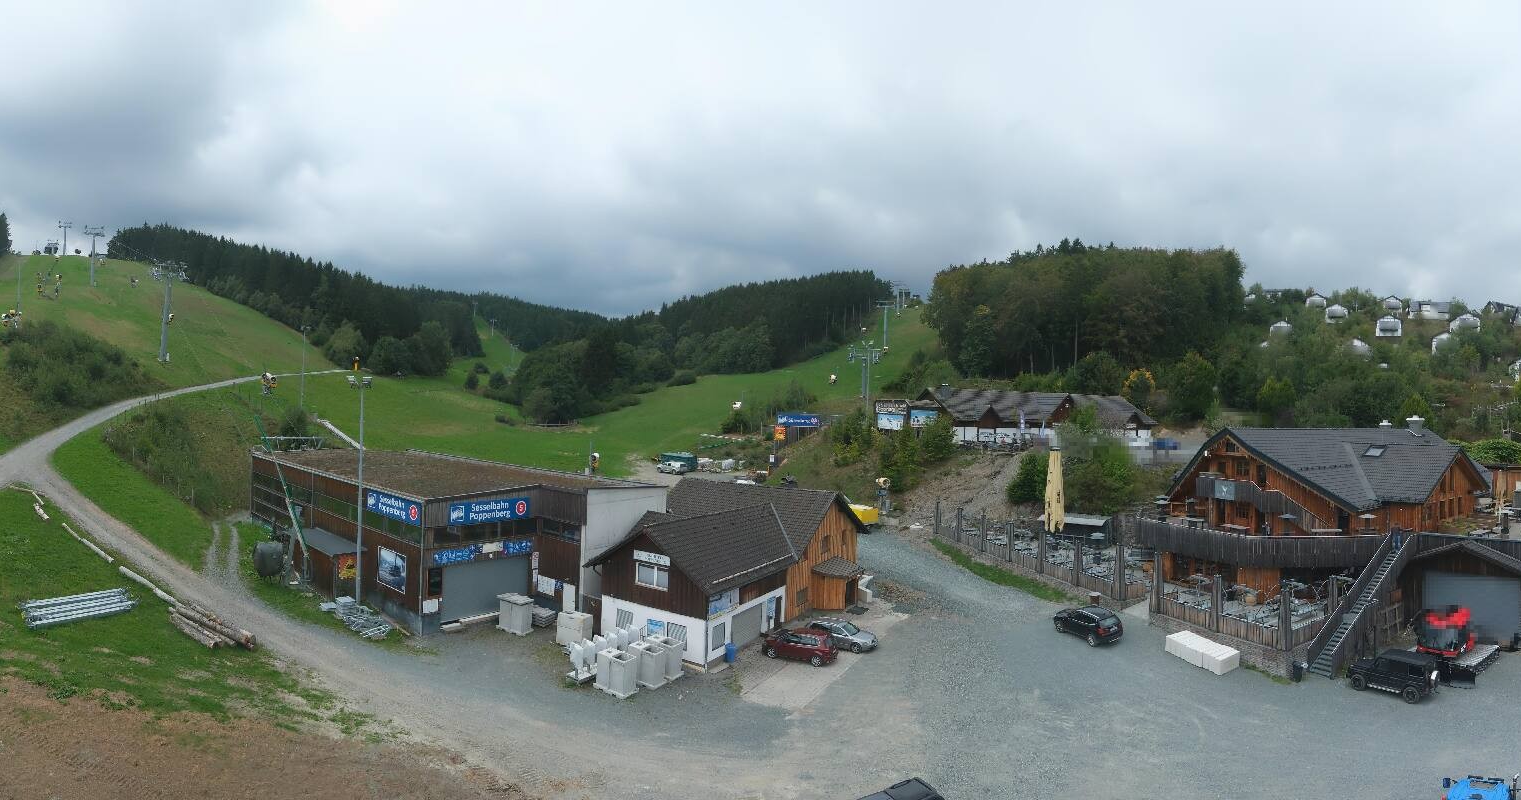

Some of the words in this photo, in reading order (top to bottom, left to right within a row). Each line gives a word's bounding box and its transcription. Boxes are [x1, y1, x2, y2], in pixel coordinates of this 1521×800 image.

[379, 495, 405, 509] Sesselbahn
[471, 501, 509, 512] Sesselbahn
[518, 504, 524, 512] 5
[378, 502, 406, 519] Poppenberg
[469, 509, 511, 521] Poppenberg
